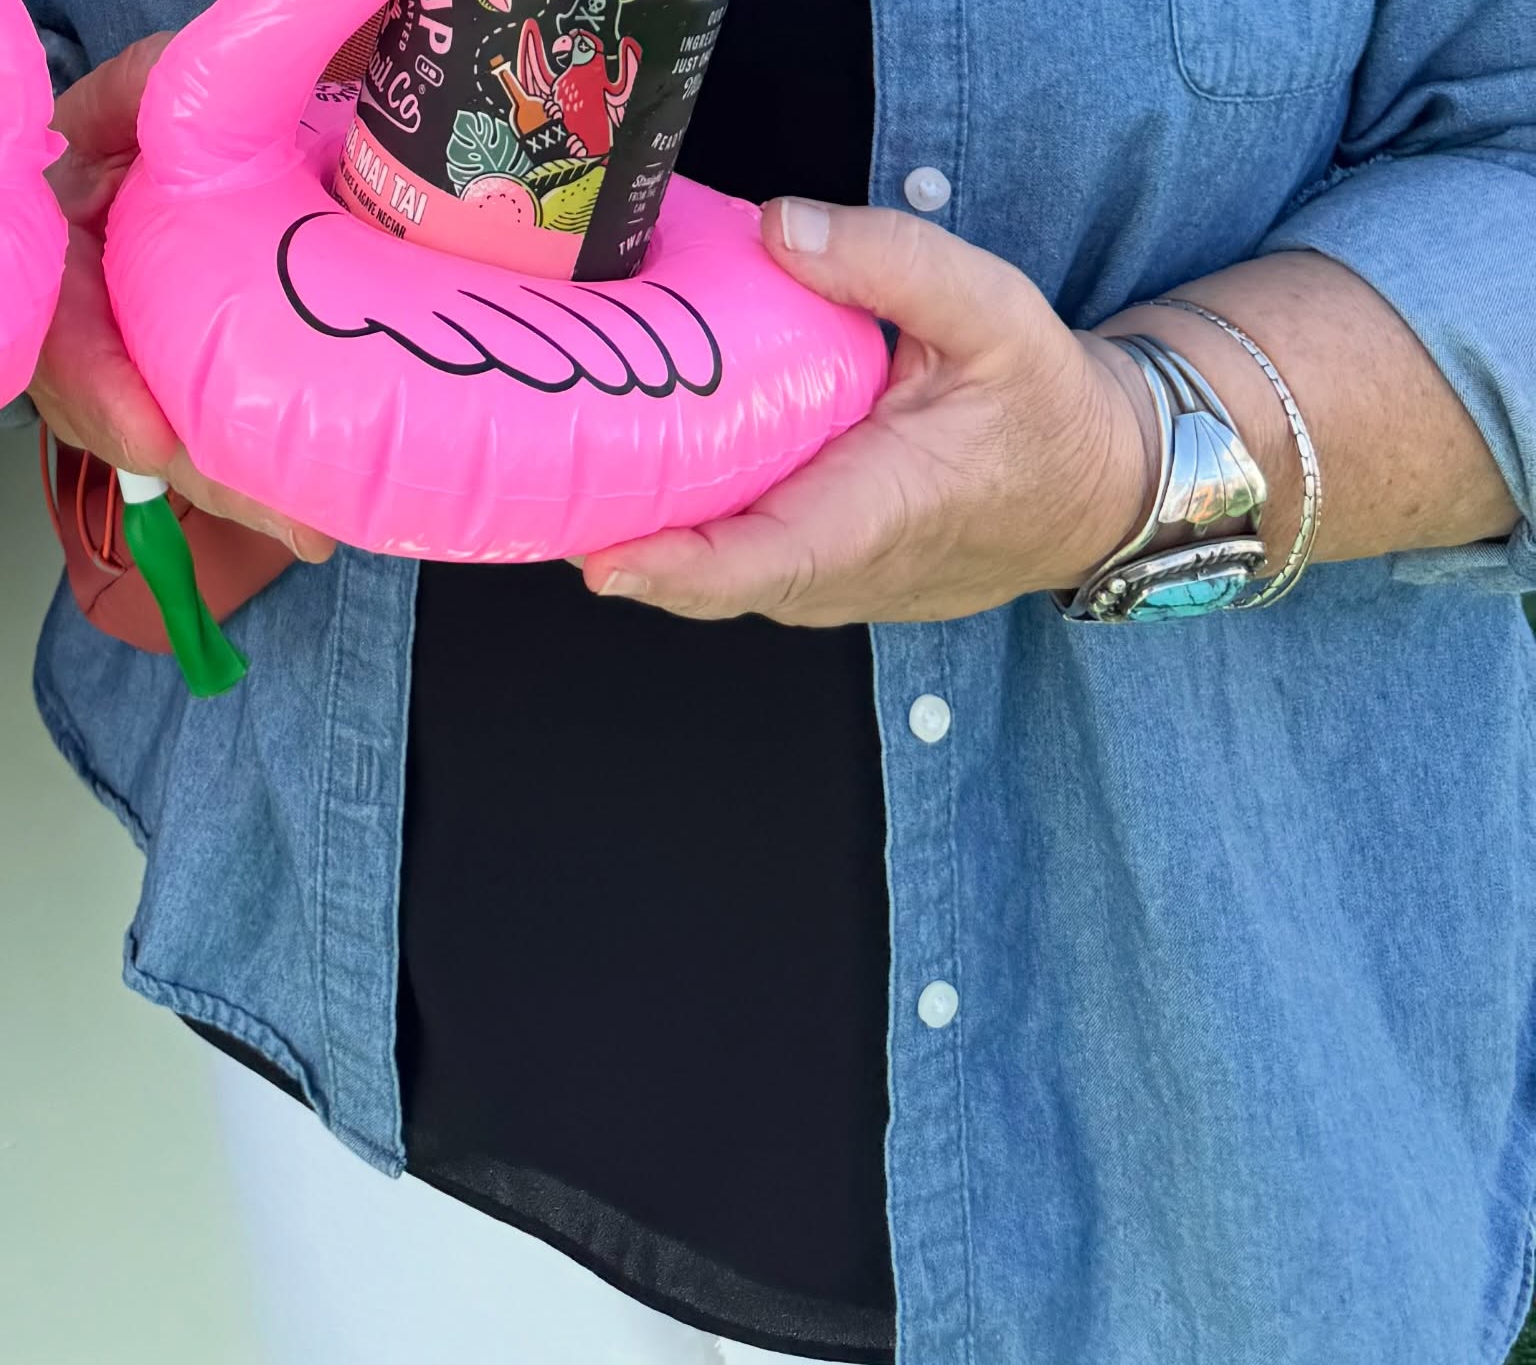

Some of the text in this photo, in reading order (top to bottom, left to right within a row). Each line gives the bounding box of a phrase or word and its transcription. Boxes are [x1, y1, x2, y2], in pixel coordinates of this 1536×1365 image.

[672, 55, 699, 74] JUST
[355, 139, 389, 197] MAI
[390, 173, 428, 225] TAI
[357, 190, 377, 216] AGAVE
[376, 208, 407, 239] NECTAR
